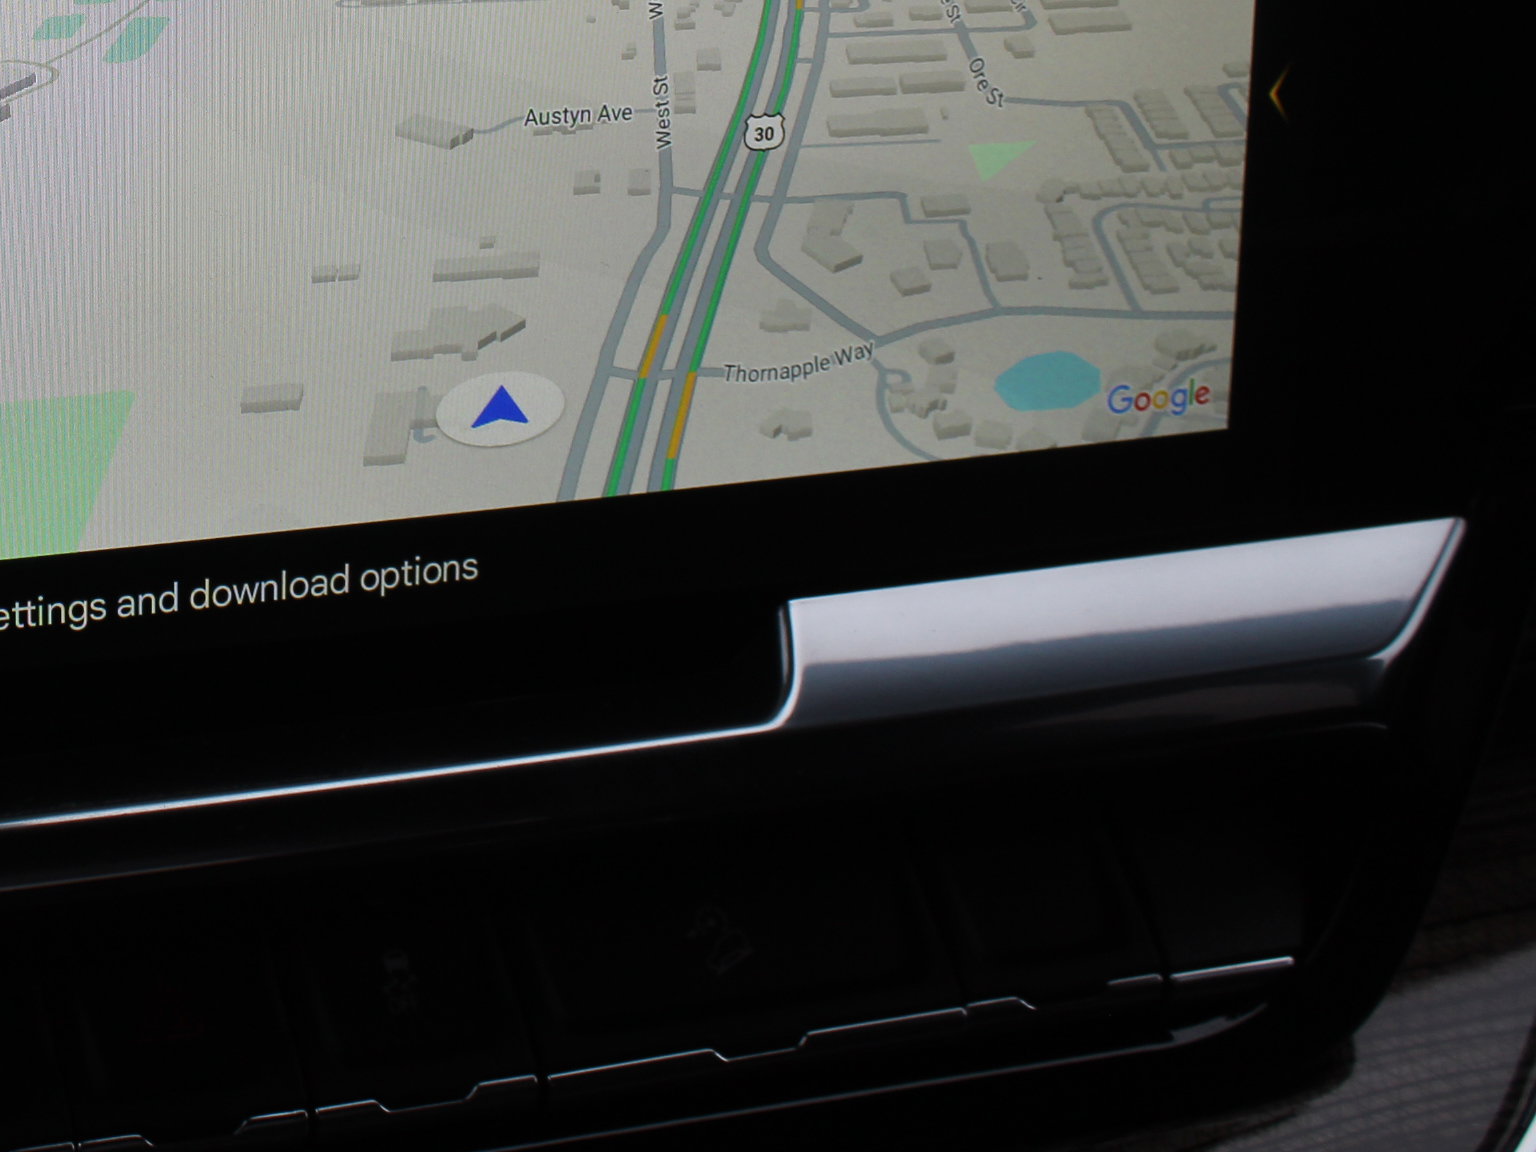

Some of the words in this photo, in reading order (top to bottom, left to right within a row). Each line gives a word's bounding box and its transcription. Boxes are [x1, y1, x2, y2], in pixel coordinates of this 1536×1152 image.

[946, 3, 961, 24] St
[653, 76, 668, 100] St
[969, 58, 989, 91] Ore
[986, 87, 1004, 109] St
[524, 106, 592, 130] Austyn
[597, 105, 633, 123] Ave
[656, 102, 672, 149] West
[754, 126, 775, 143] 30
[724, 356, 831, 383] Thornapple
[833, 340, 875, 368] Way
[1107, 378, 1211, 416] Google
[117, 582, 179, 618] and
[190, 564, 350, 611] download
[361, 554, 479, 597] options
